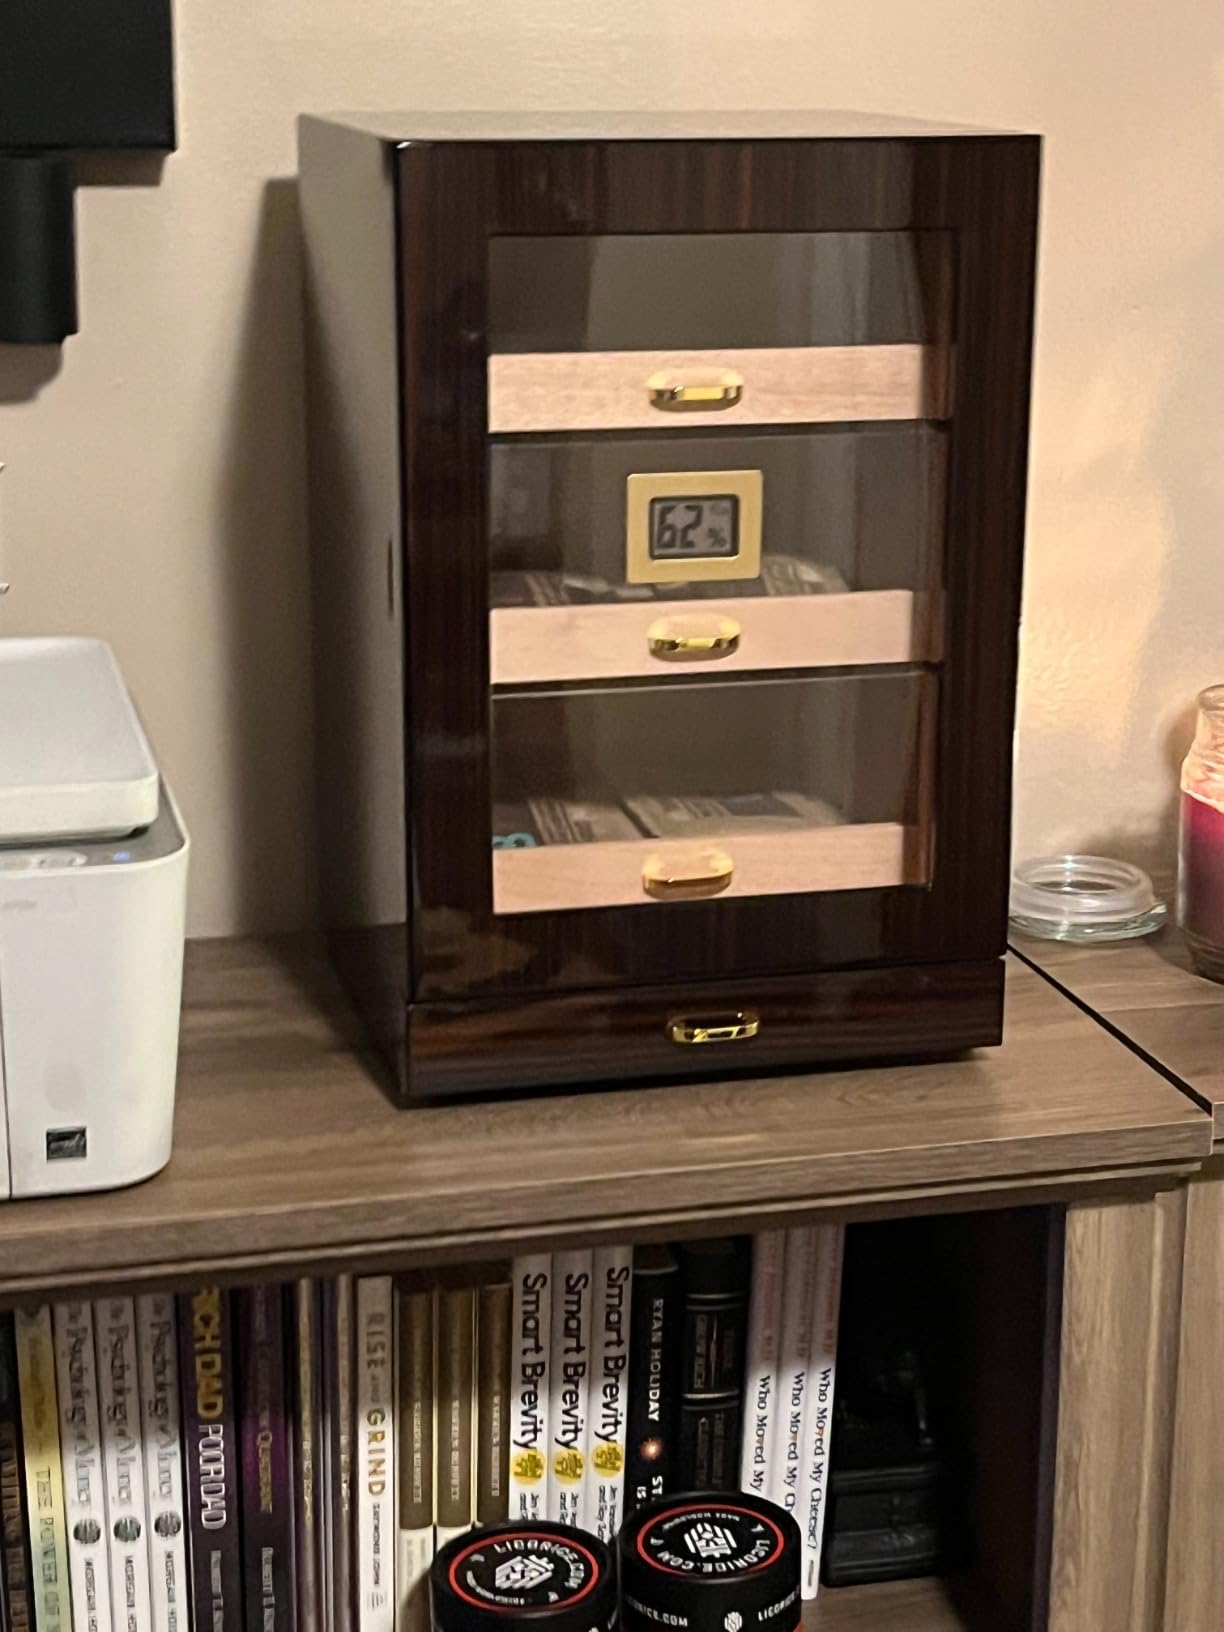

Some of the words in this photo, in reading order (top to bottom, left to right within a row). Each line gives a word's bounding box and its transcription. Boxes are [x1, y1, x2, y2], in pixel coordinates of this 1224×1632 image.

[522, 1271, 548, 1355] Smart
[563, 1272, 589, 1354] Smart
[604, 1266, 631, 1349] Smart
[650, 1297, 665, 1344] RYAN
[366, 1312, 387, 1369] RISE
[196, 1353, 224, 1419] DAD
[513, 1360, 546, 1449] Brevity
[554, 1361, 587, 1448] Brevity
[594, 1353, 627, 1443] Brevity
[647, 1348, 662, 1422] HOLIDAY
[756, 1374, 771, 1410] Who
[790, 1371, 806, 1407] Who
[817, 1367, 832, 1403] Who
[366, 1407, 387, 1496] GRIND
[752, 1414, 768, 1464] Moved
[785, 1411, 802, 1460] Moved
[812, 1406, 828, 1457] Moved
[750, 1469, 765, 1492] My
[782, 1466, 798, 1488] My
[809, 1462, 824, 1485] My
